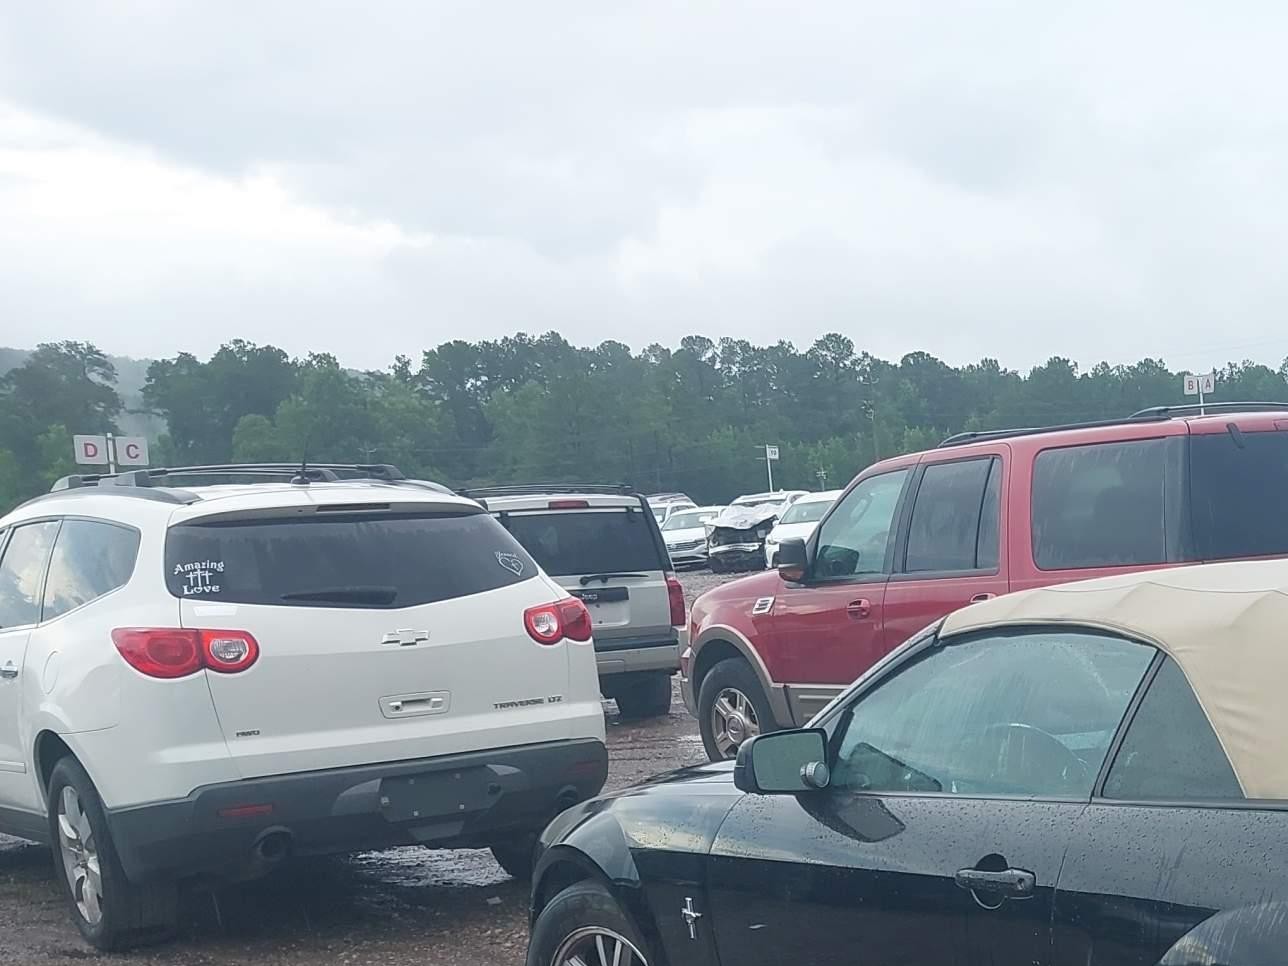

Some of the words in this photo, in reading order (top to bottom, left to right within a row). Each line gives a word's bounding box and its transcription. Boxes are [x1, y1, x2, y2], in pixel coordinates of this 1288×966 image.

[1188, 380, 1194, 390] B
[1205, 379, 1211, 389] A
[84, 443, 98, 457] D
[126, 444, 140, 459] C
[174, 560, 224, 574] Amazing
[183, 585, 220, 594] Love
